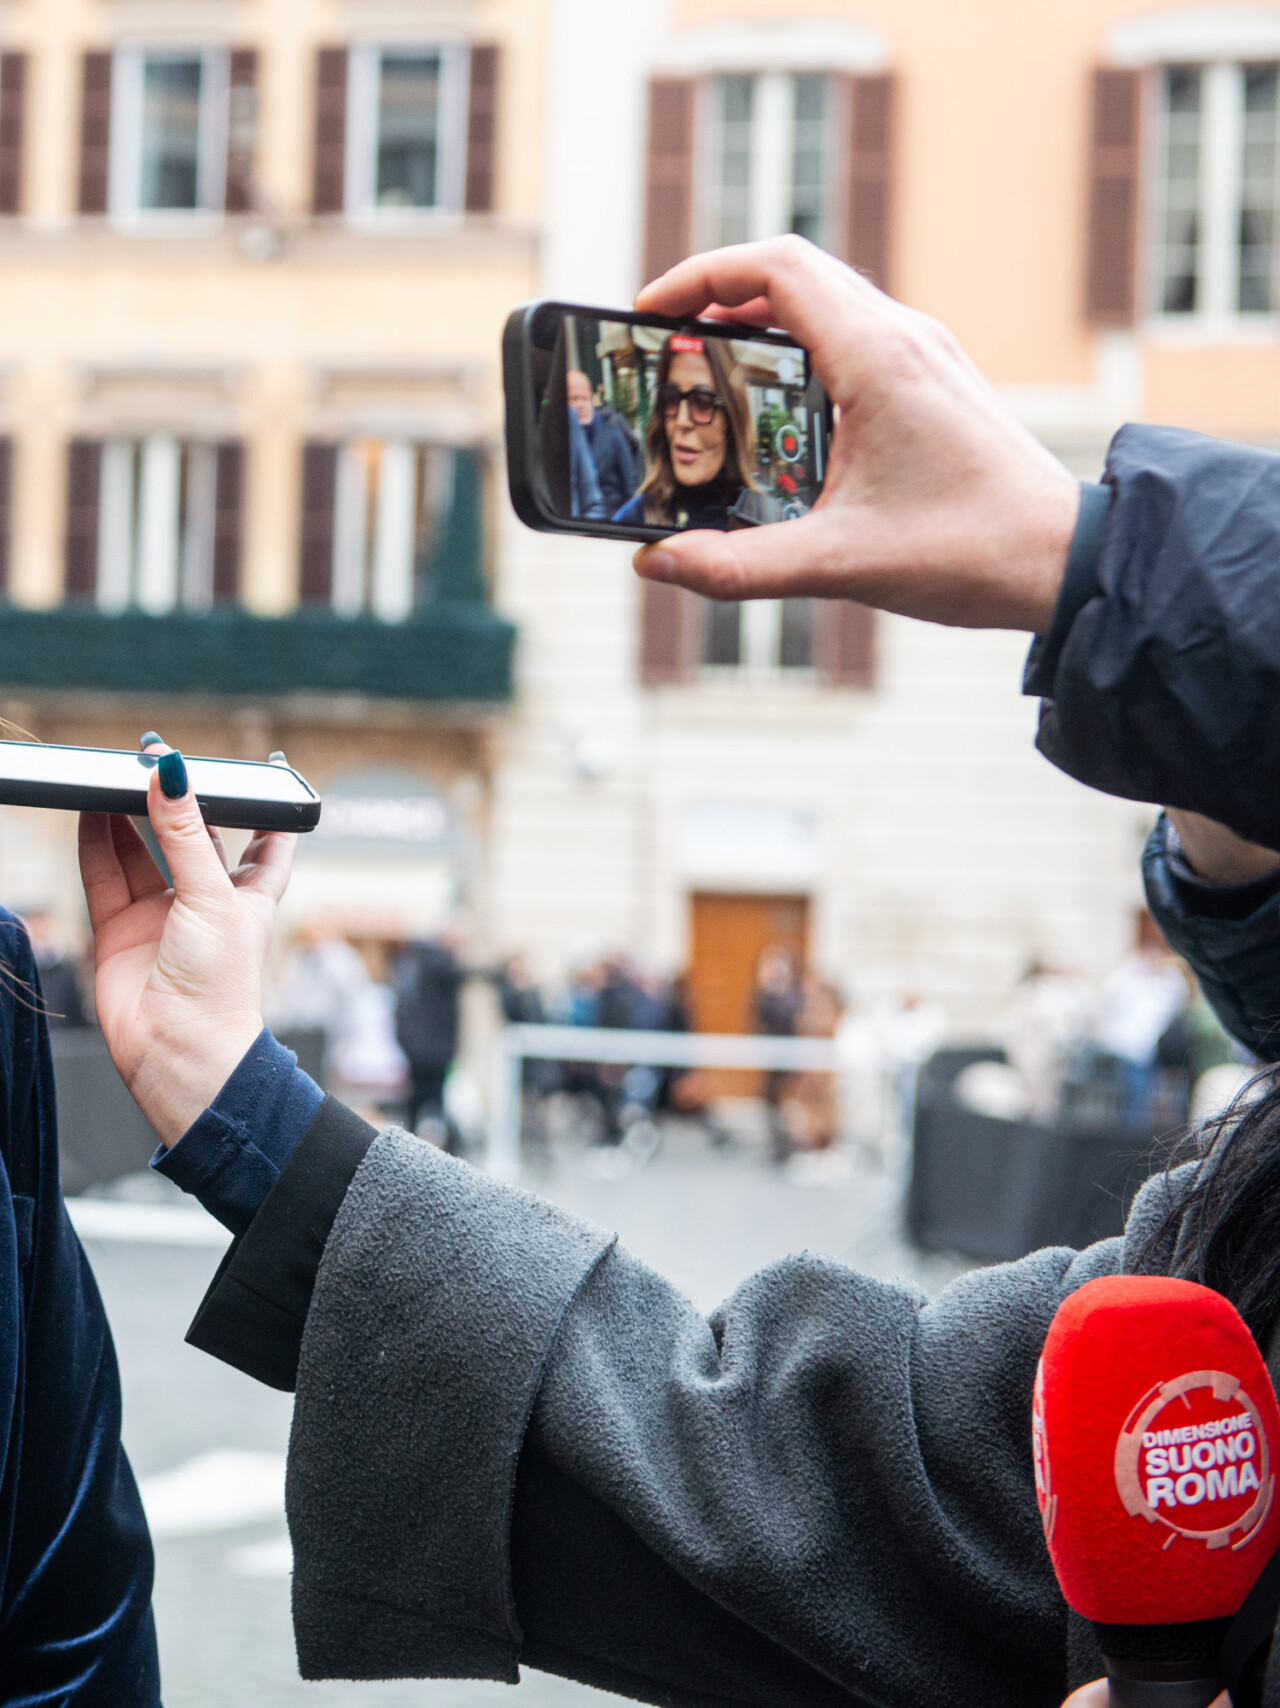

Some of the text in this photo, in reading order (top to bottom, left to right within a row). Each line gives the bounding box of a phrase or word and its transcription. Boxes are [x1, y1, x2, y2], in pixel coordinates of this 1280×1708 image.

[1143, 1412, 1252, 1448] DIMENSIONE
[1146, 1431, 1255, 1476] SUONO
[1147, 1462, 1259, 1508] ROMA
